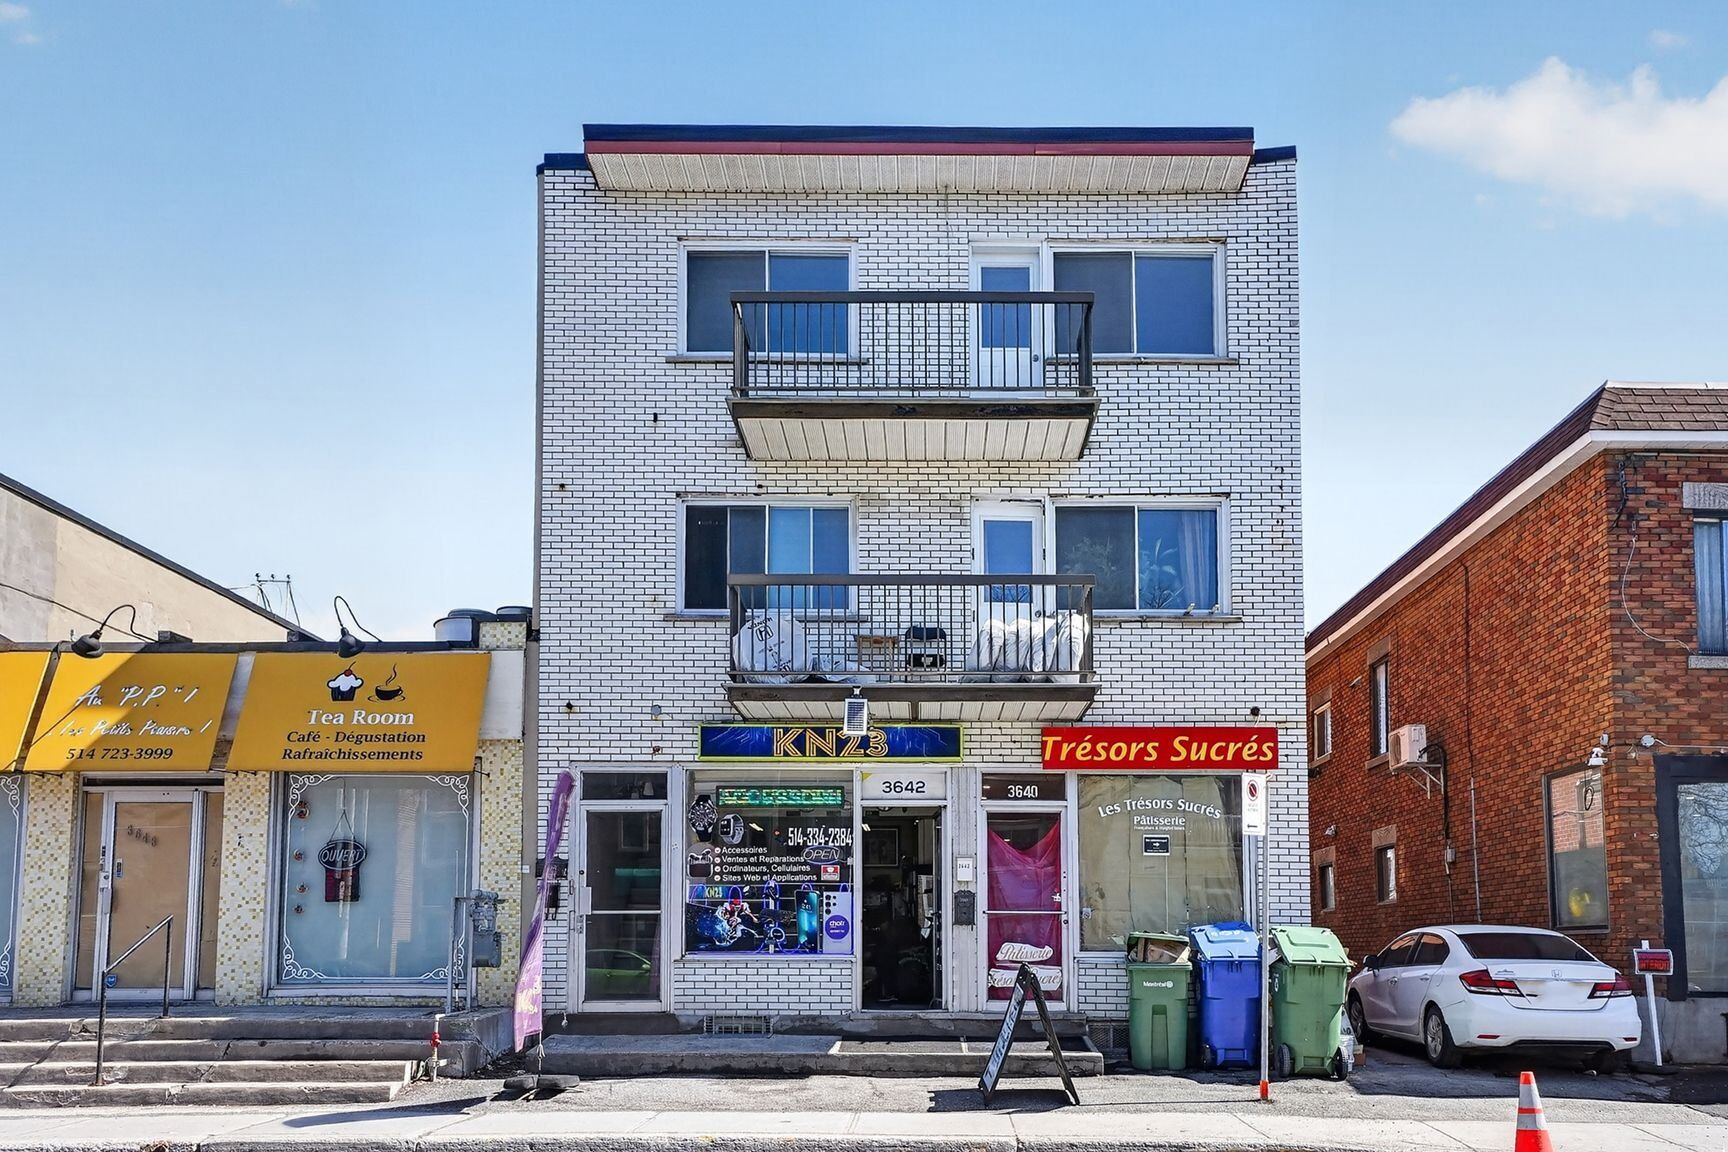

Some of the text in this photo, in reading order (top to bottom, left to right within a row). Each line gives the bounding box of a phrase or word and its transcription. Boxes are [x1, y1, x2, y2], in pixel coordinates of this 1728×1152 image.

[307, 709, 415, 725] Tea Room
[286, 730, 321, 743] Café
[334, 730, 426, 745] Dégustation
[773, 727, 889, 757] KN23
[66, 747, 174, 760] 514 723-3999
[282, 747, 424, 760] Rafraîchissements
[1042, 734, 1275, 762] Trésors Sucrés
[882, 780, 927, 794] 3642
[1007, 784, 1038, 798] 3640
[1097, 797, 1222, 820] Les Trésors Sucrés
[1133, 815, 1186, 826] Pâtisserie
[787, 827, 853, 846] 514-334-2384
[320, 848, 365, 864] OUVERT
[721, 846, 768, 855] Accessoires
[803, 848, 841, 861] OPEN
[721, 855, 747, 864] Ventes
[749, 856, 757, 864] et
[771, 864, 811, 873] Cellulaires
[743, 873, 761, 882] Web
